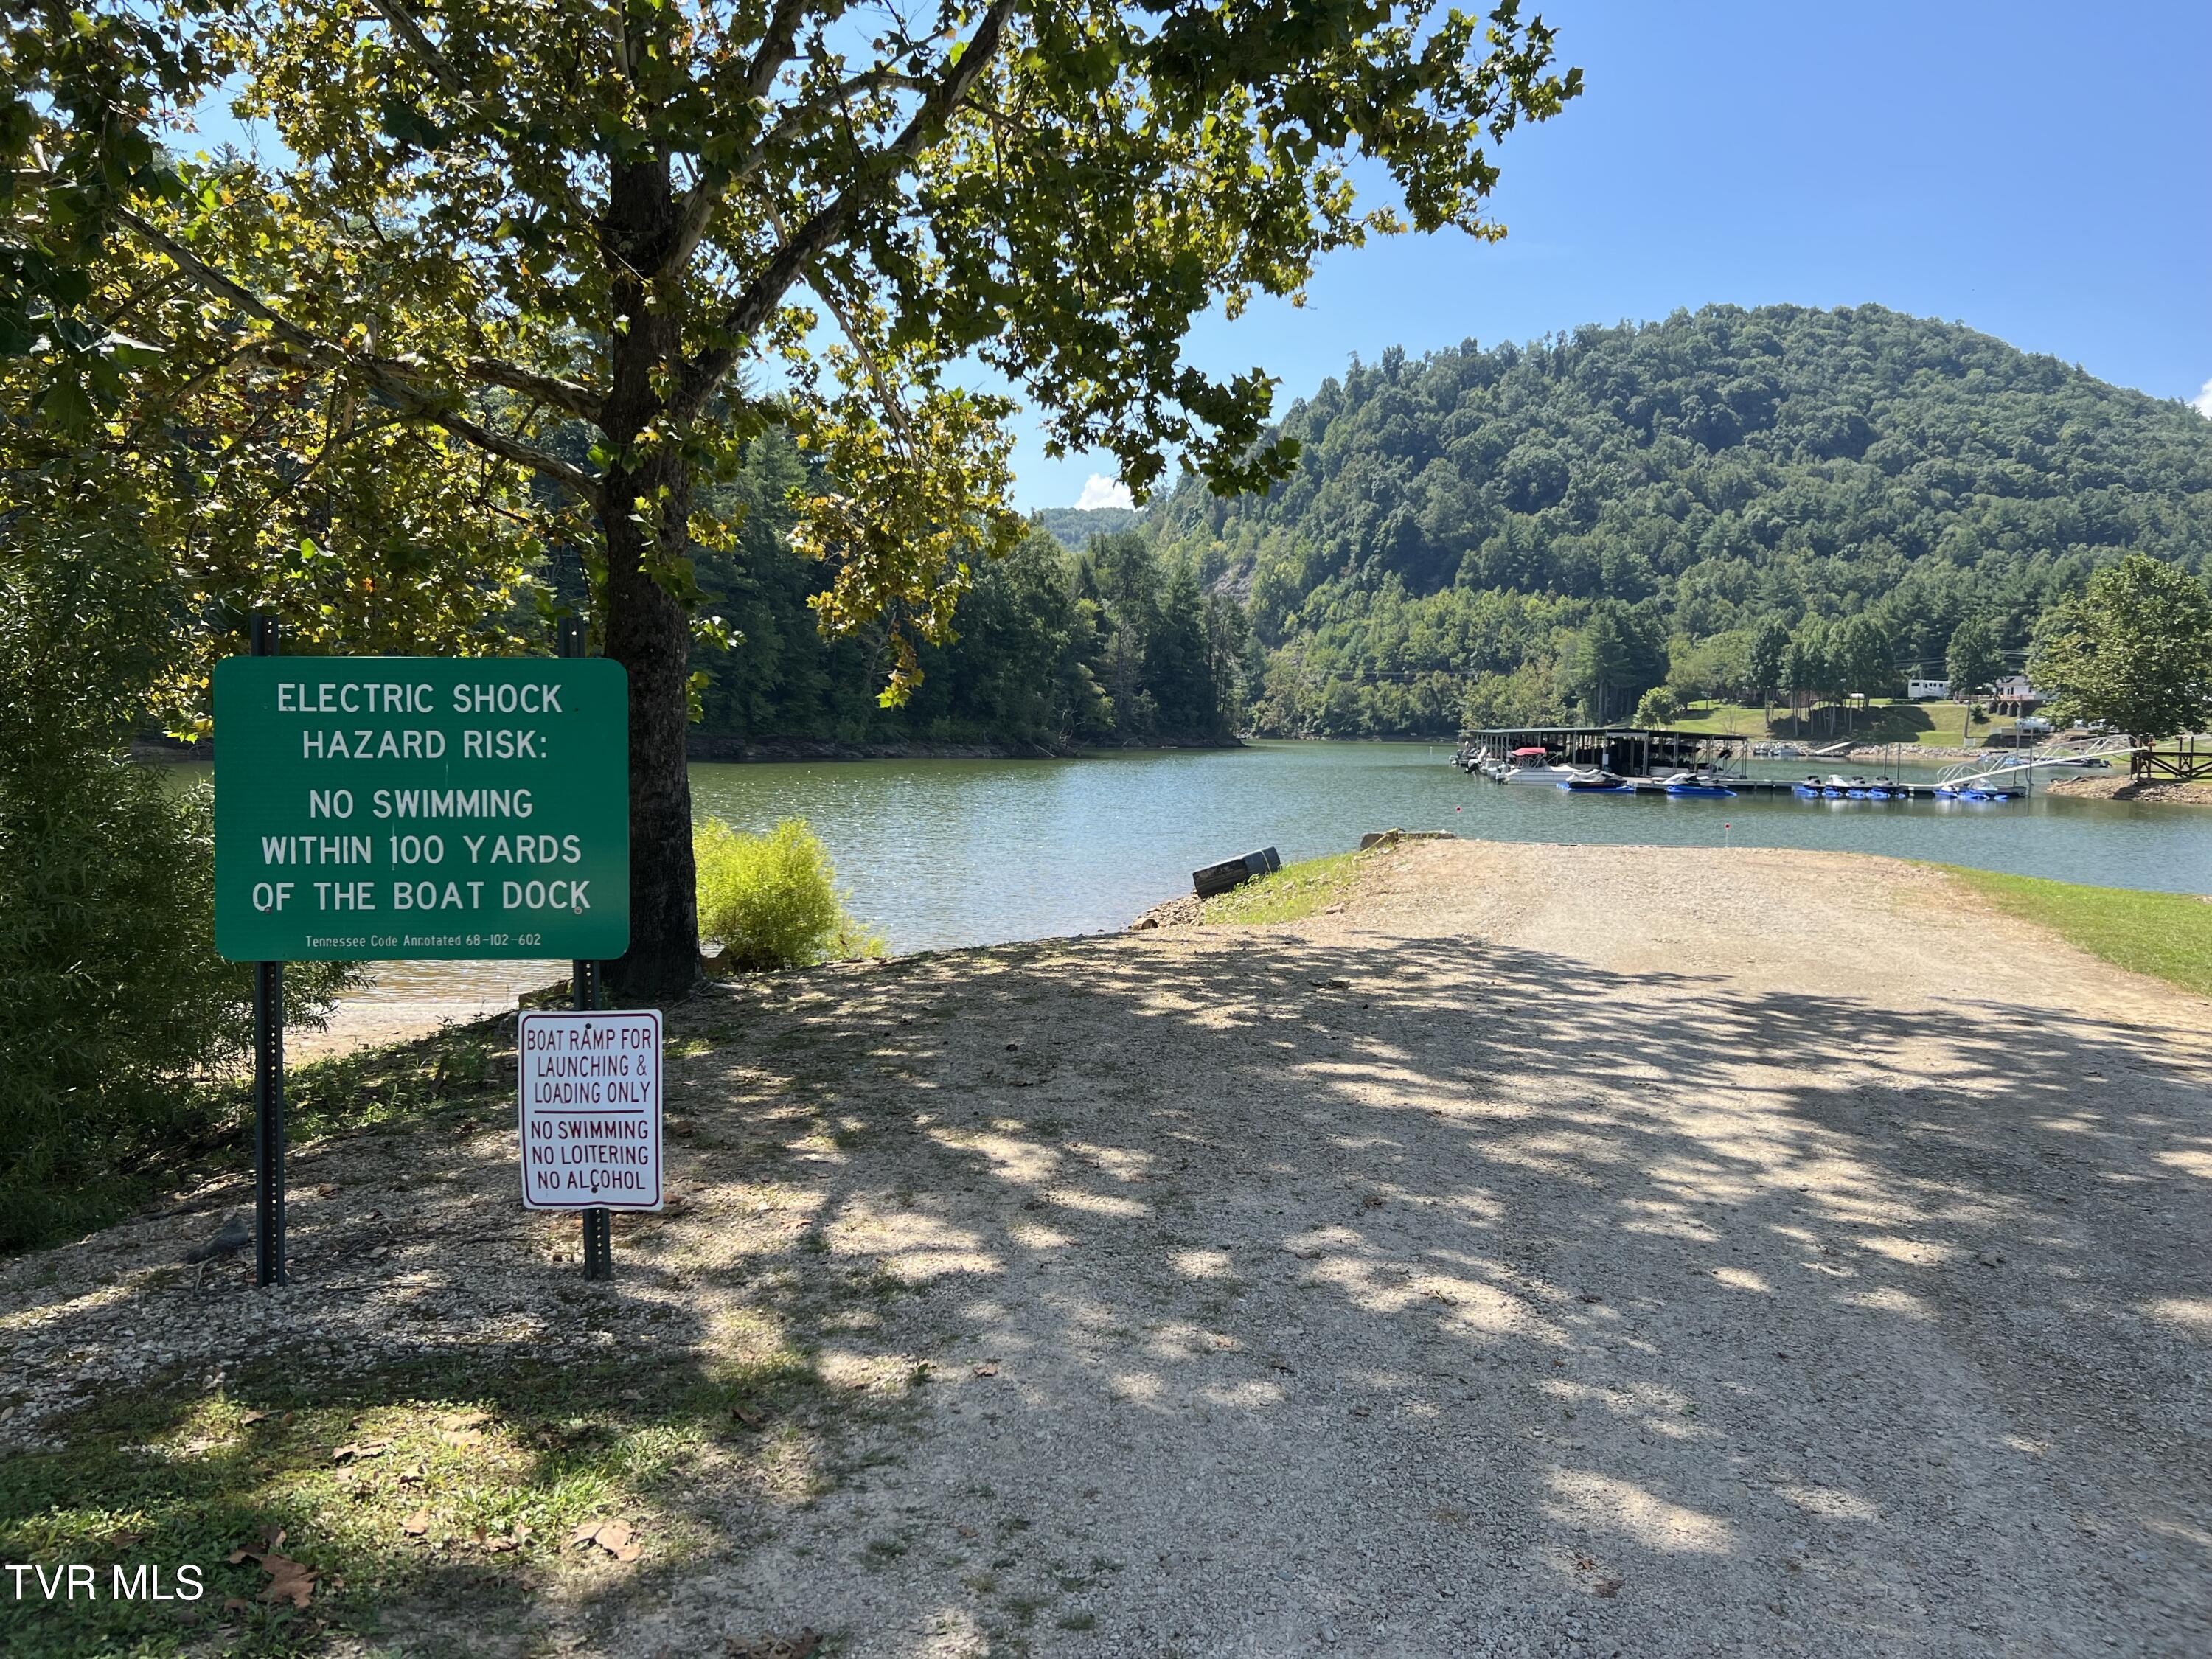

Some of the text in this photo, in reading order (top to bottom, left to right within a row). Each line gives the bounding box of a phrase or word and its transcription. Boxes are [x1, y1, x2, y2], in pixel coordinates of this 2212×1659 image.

[277, 684, 563, 713] ELECTRIC SHOCK
[303, 730, 547, 759] HAZARD RISK:
[310, 789, 532, 818] NO SWIMMING
[262, 835, 582, 865] WITHIN 100 YARDS
[252, 880, 591, 911] OF THE BOAT DOCK
[306, 933, 541, 947] Tennessee Code Annotated 68-102-602
[527, 1028, 652, 1051] BOAT RAMP FOR
[538, 1054, 647, 1077] LAUNCHING &
[535, 1081, 651, 1104] LOADING ONLY
[531, 1120, 648, 1139] NO SWIMMING
[532, 1145, 648, 1165] NO LOITERING
[538, 1169, 646, 1189] NO ALCOHOL
